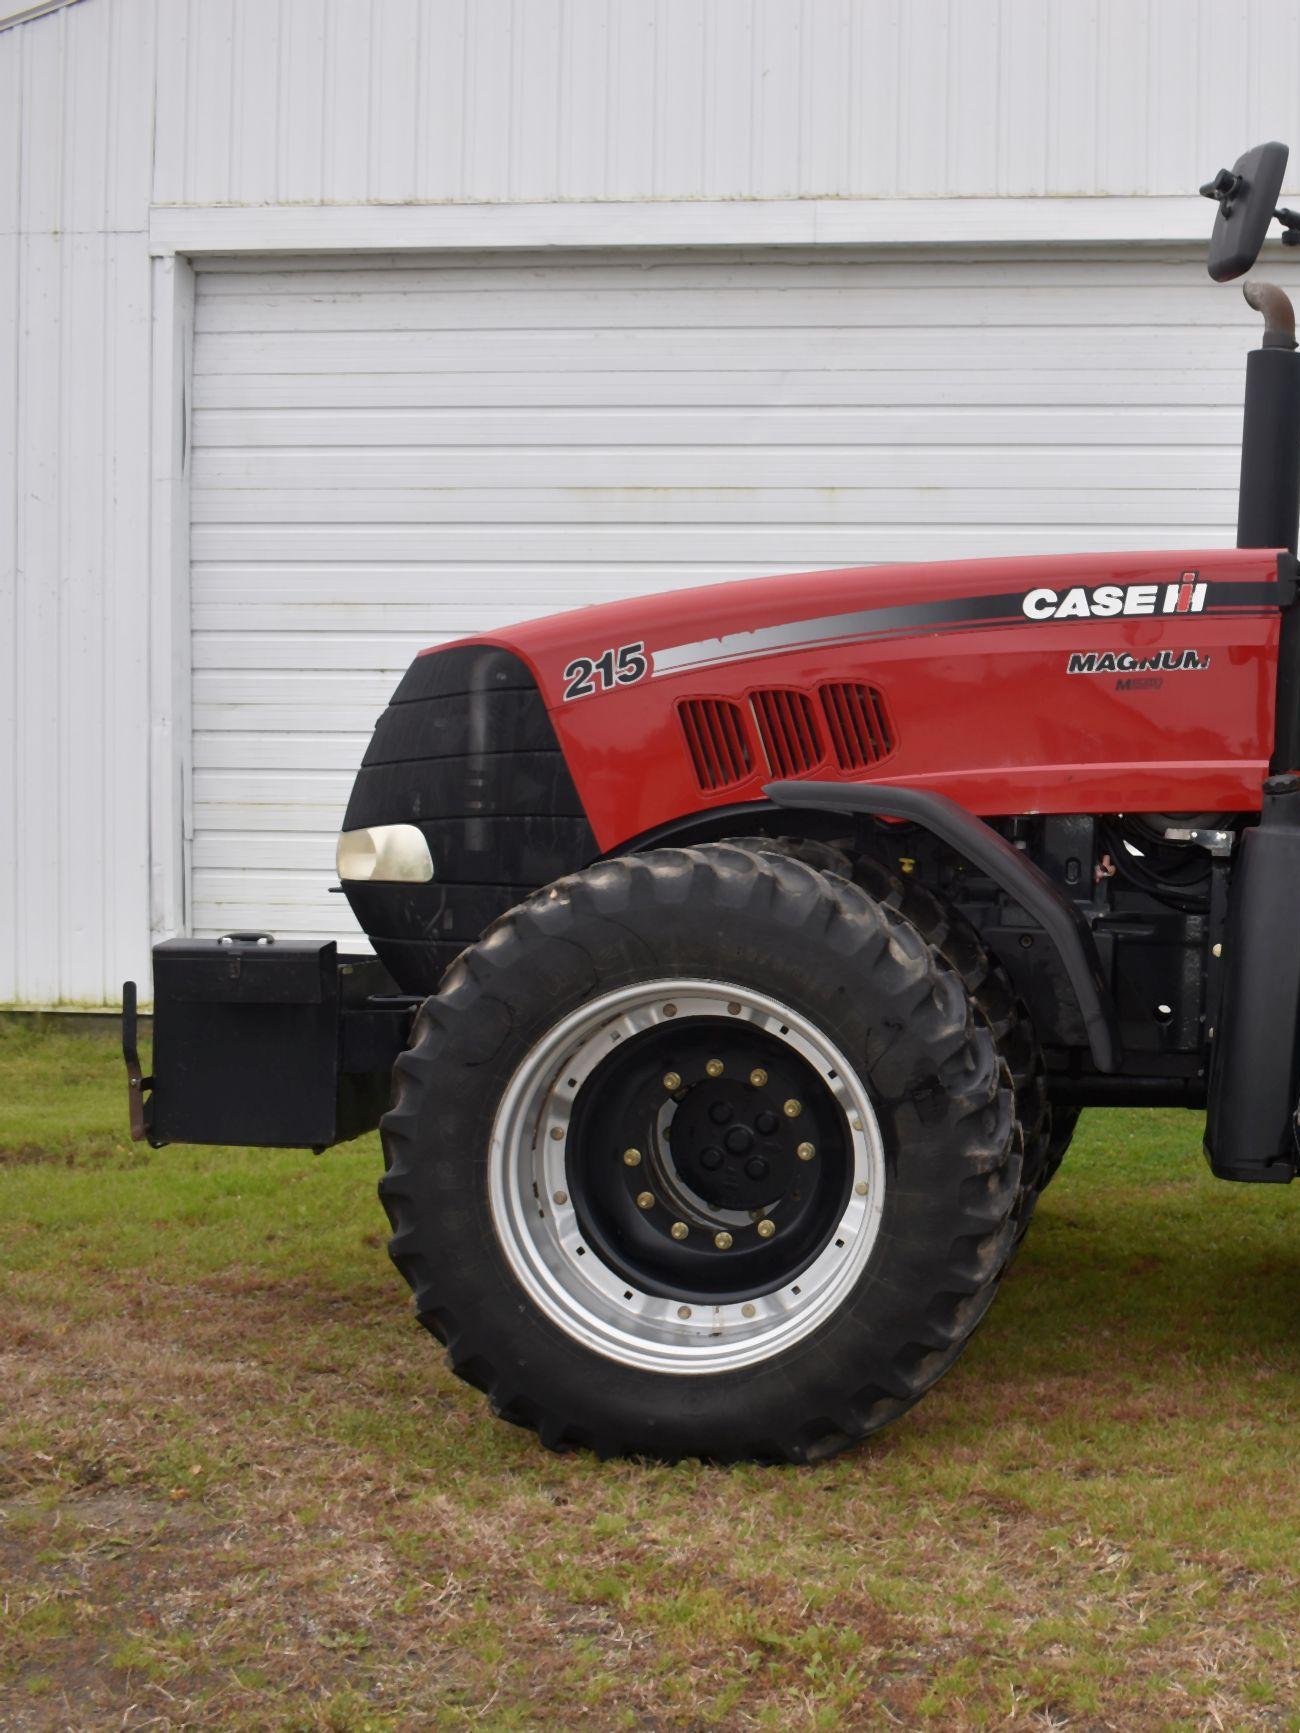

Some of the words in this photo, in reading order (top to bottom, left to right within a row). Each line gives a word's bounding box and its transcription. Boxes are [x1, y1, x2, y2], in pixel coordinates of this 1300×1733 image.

[1022, 586, 1158, 619] CASE
[563, 641, 647, 702] 215
[1066, 649, 1210, 675] MAGNUM
